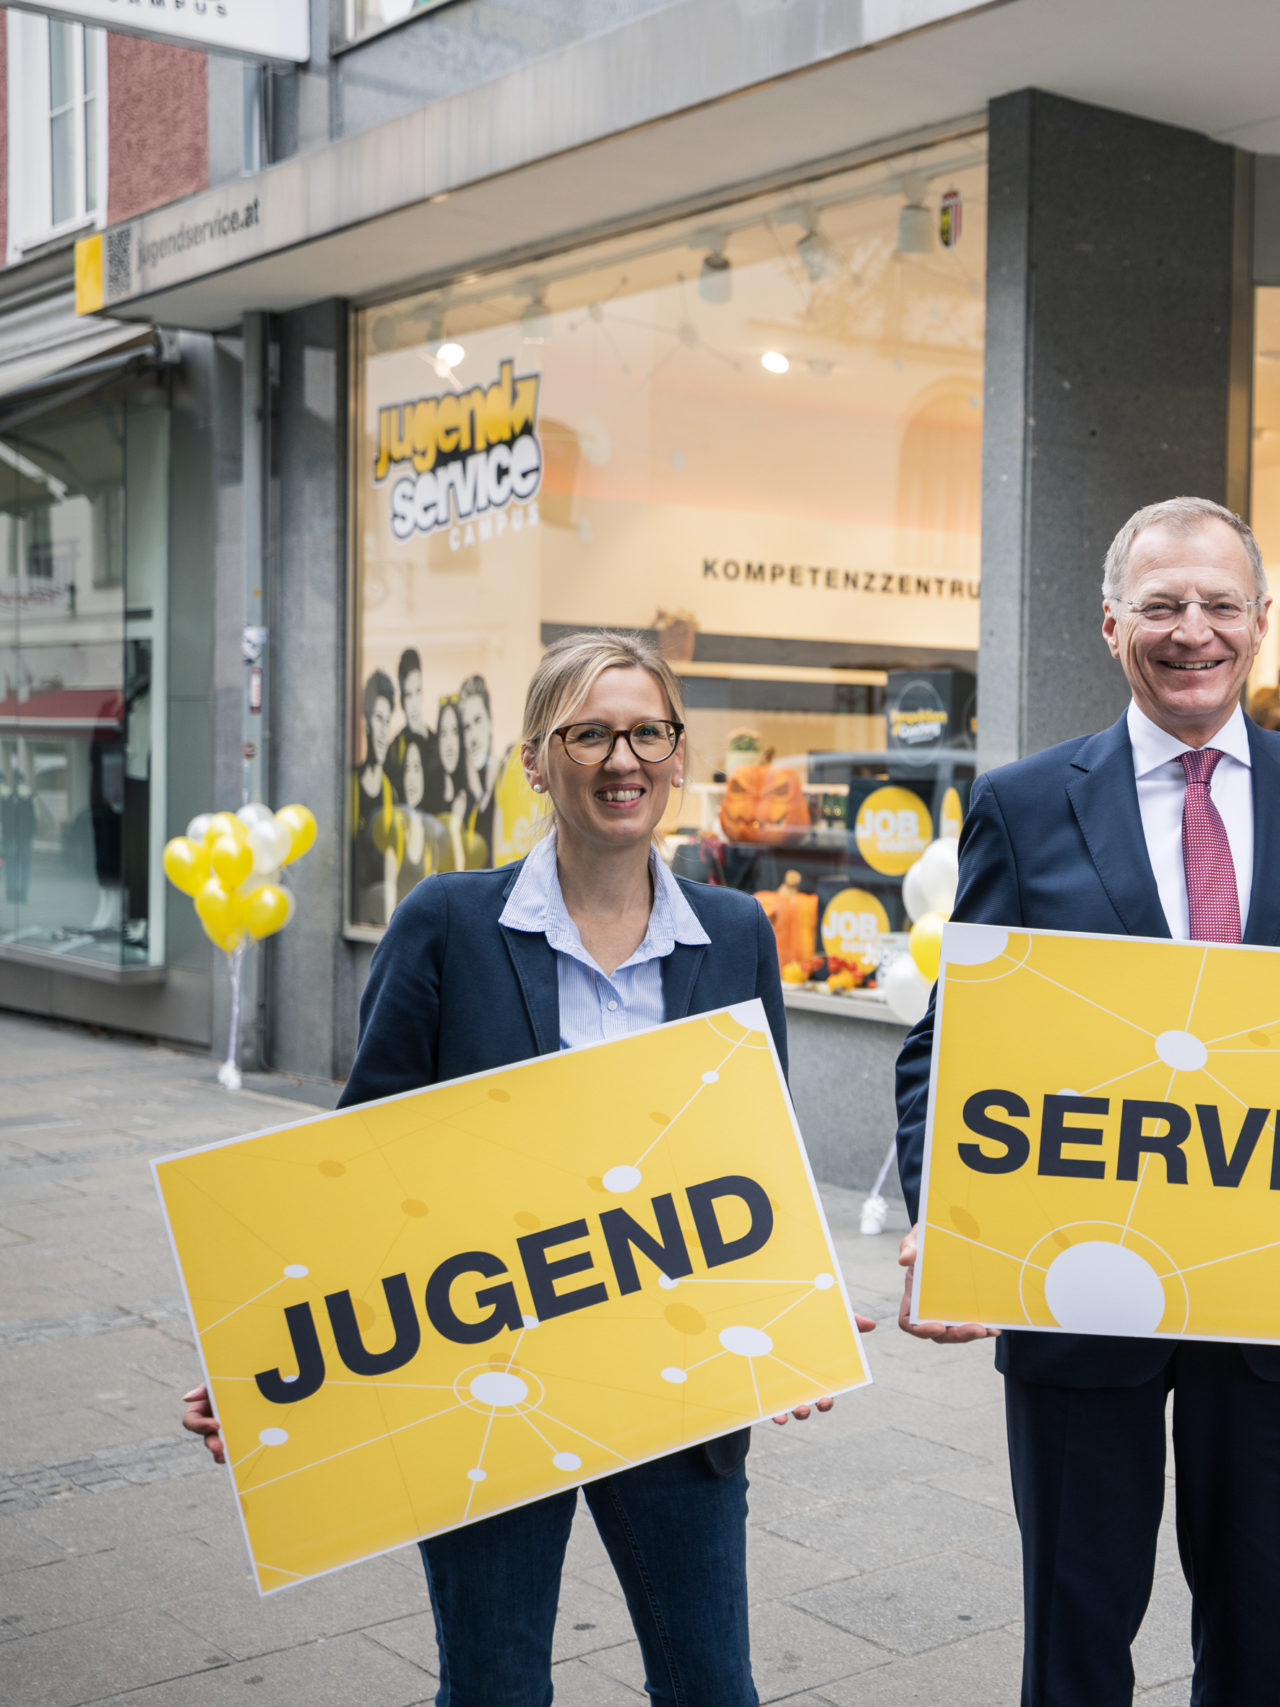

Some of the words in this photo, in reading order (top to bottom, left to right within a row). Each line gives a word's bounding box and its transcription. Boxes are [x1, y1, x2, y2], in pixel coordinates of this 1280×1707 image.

[110, 0, 227, 17] PUS
[137, 195, 260, 272] jugendservice.at
[373, 358, 516, 484] jugend
[391, 432, 542, 540] service
[448, 502, 540, 552] CAMPUS
[702, 557, 980, 600] KOMPETENZZENTRU
[857, 809, 920, 839] JOB
[821, 910, 878, 940] JOB
[253, 1174, 774, 1404] JUGEND
